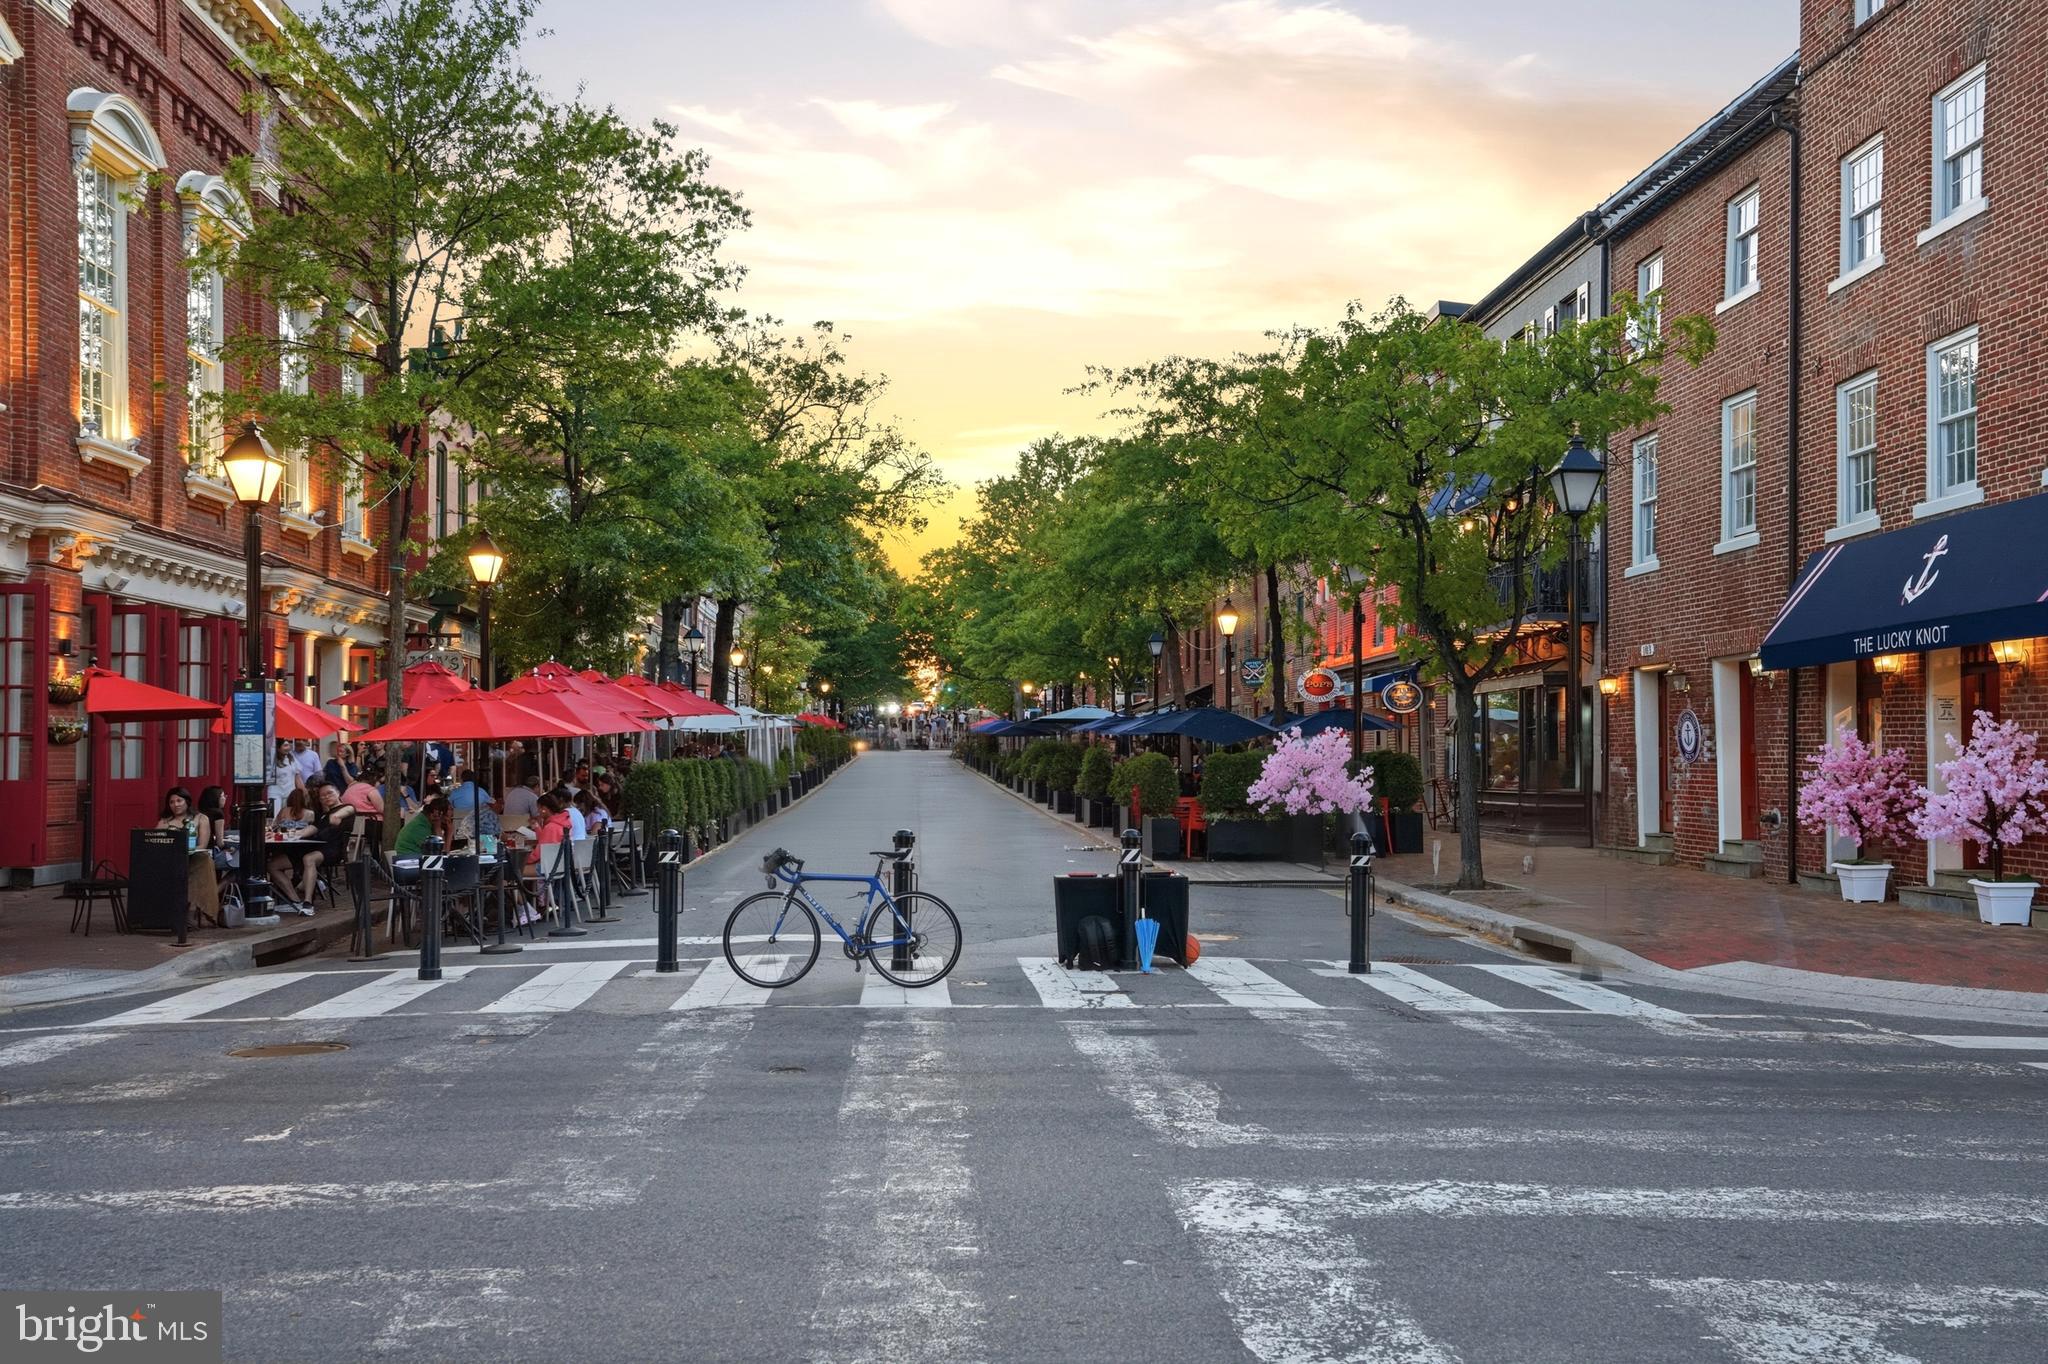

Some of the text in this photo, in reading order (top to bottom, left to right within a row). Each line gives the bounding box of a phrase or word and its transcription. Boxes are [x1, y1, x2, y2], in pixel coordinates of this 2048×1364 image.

[1853, 625, 1949, 654] THE LUCKY KNOT
